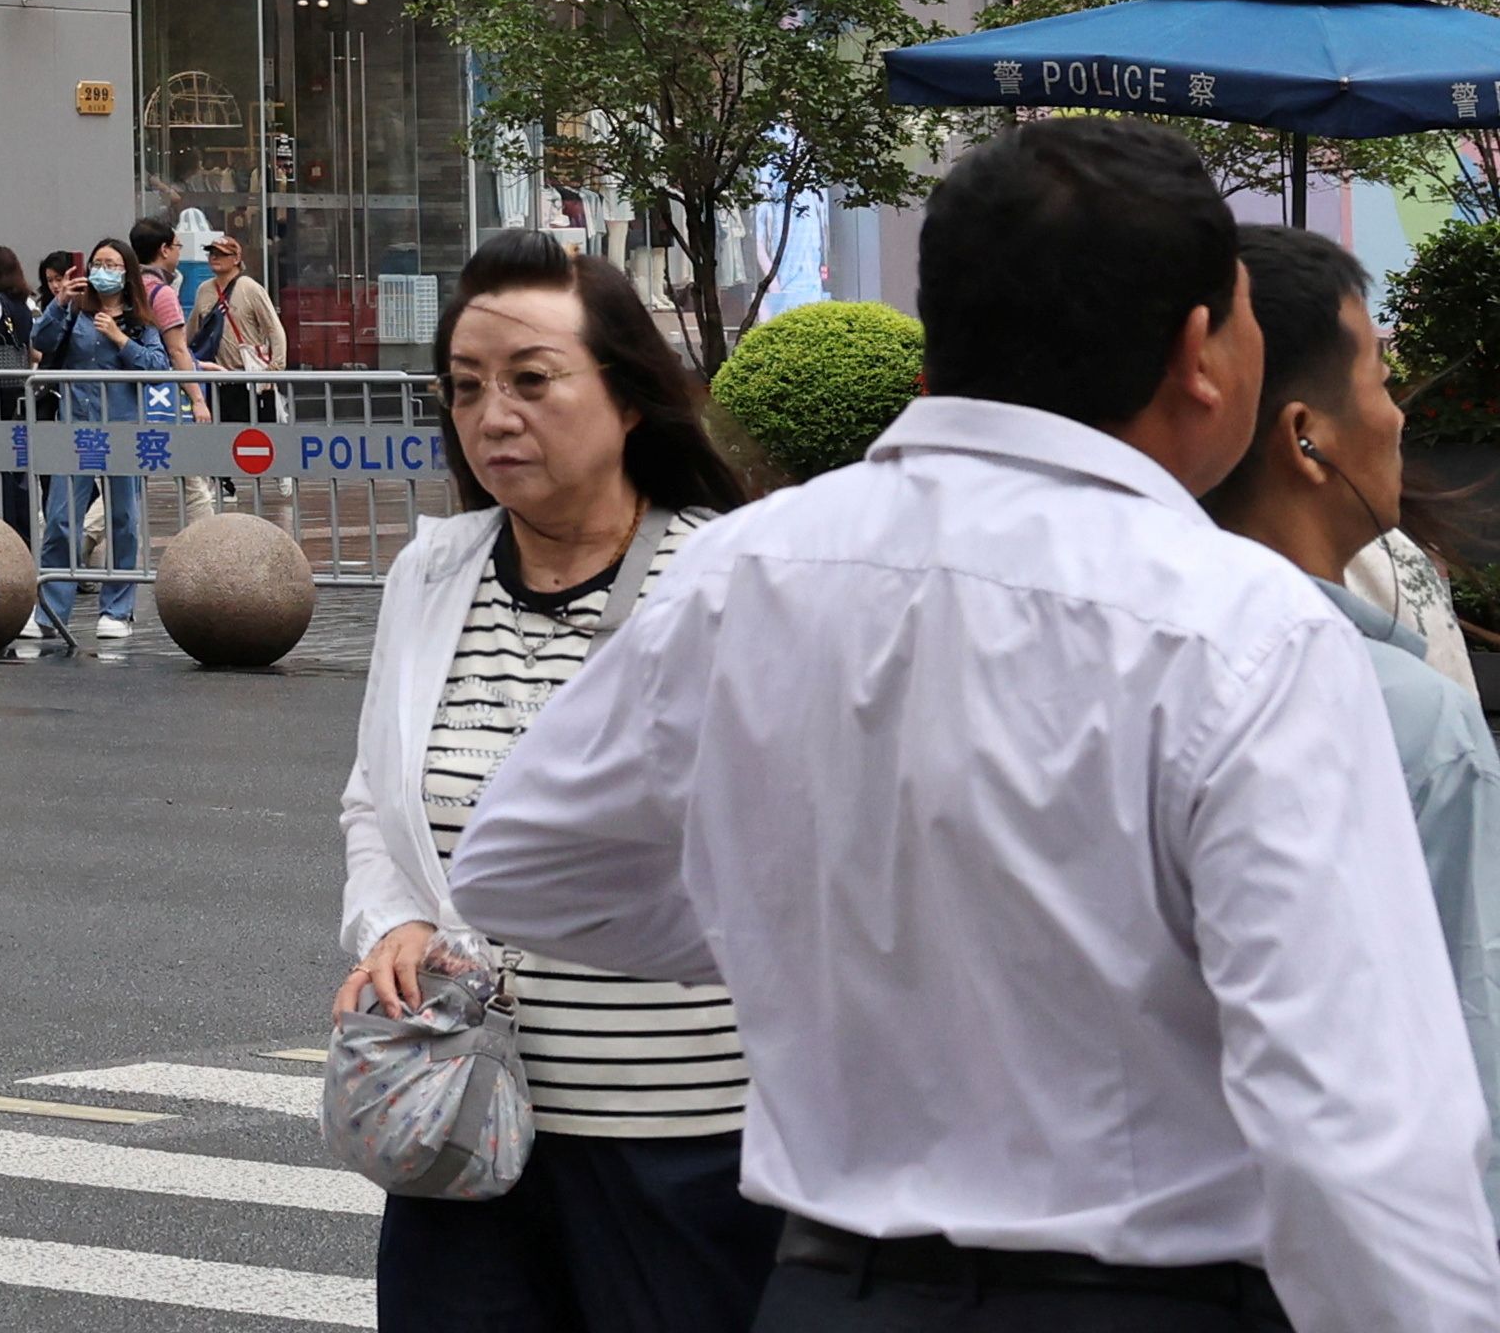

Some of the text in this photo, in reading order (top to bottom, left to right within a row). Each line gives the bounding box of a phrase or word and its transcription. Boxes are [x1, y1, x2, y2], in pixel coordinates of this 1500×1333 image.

[84, 86, 110, 102] 299
[993, 60, 1216, 108] 警 POLICE 察
[1451, 80, 1479, 120] 警
